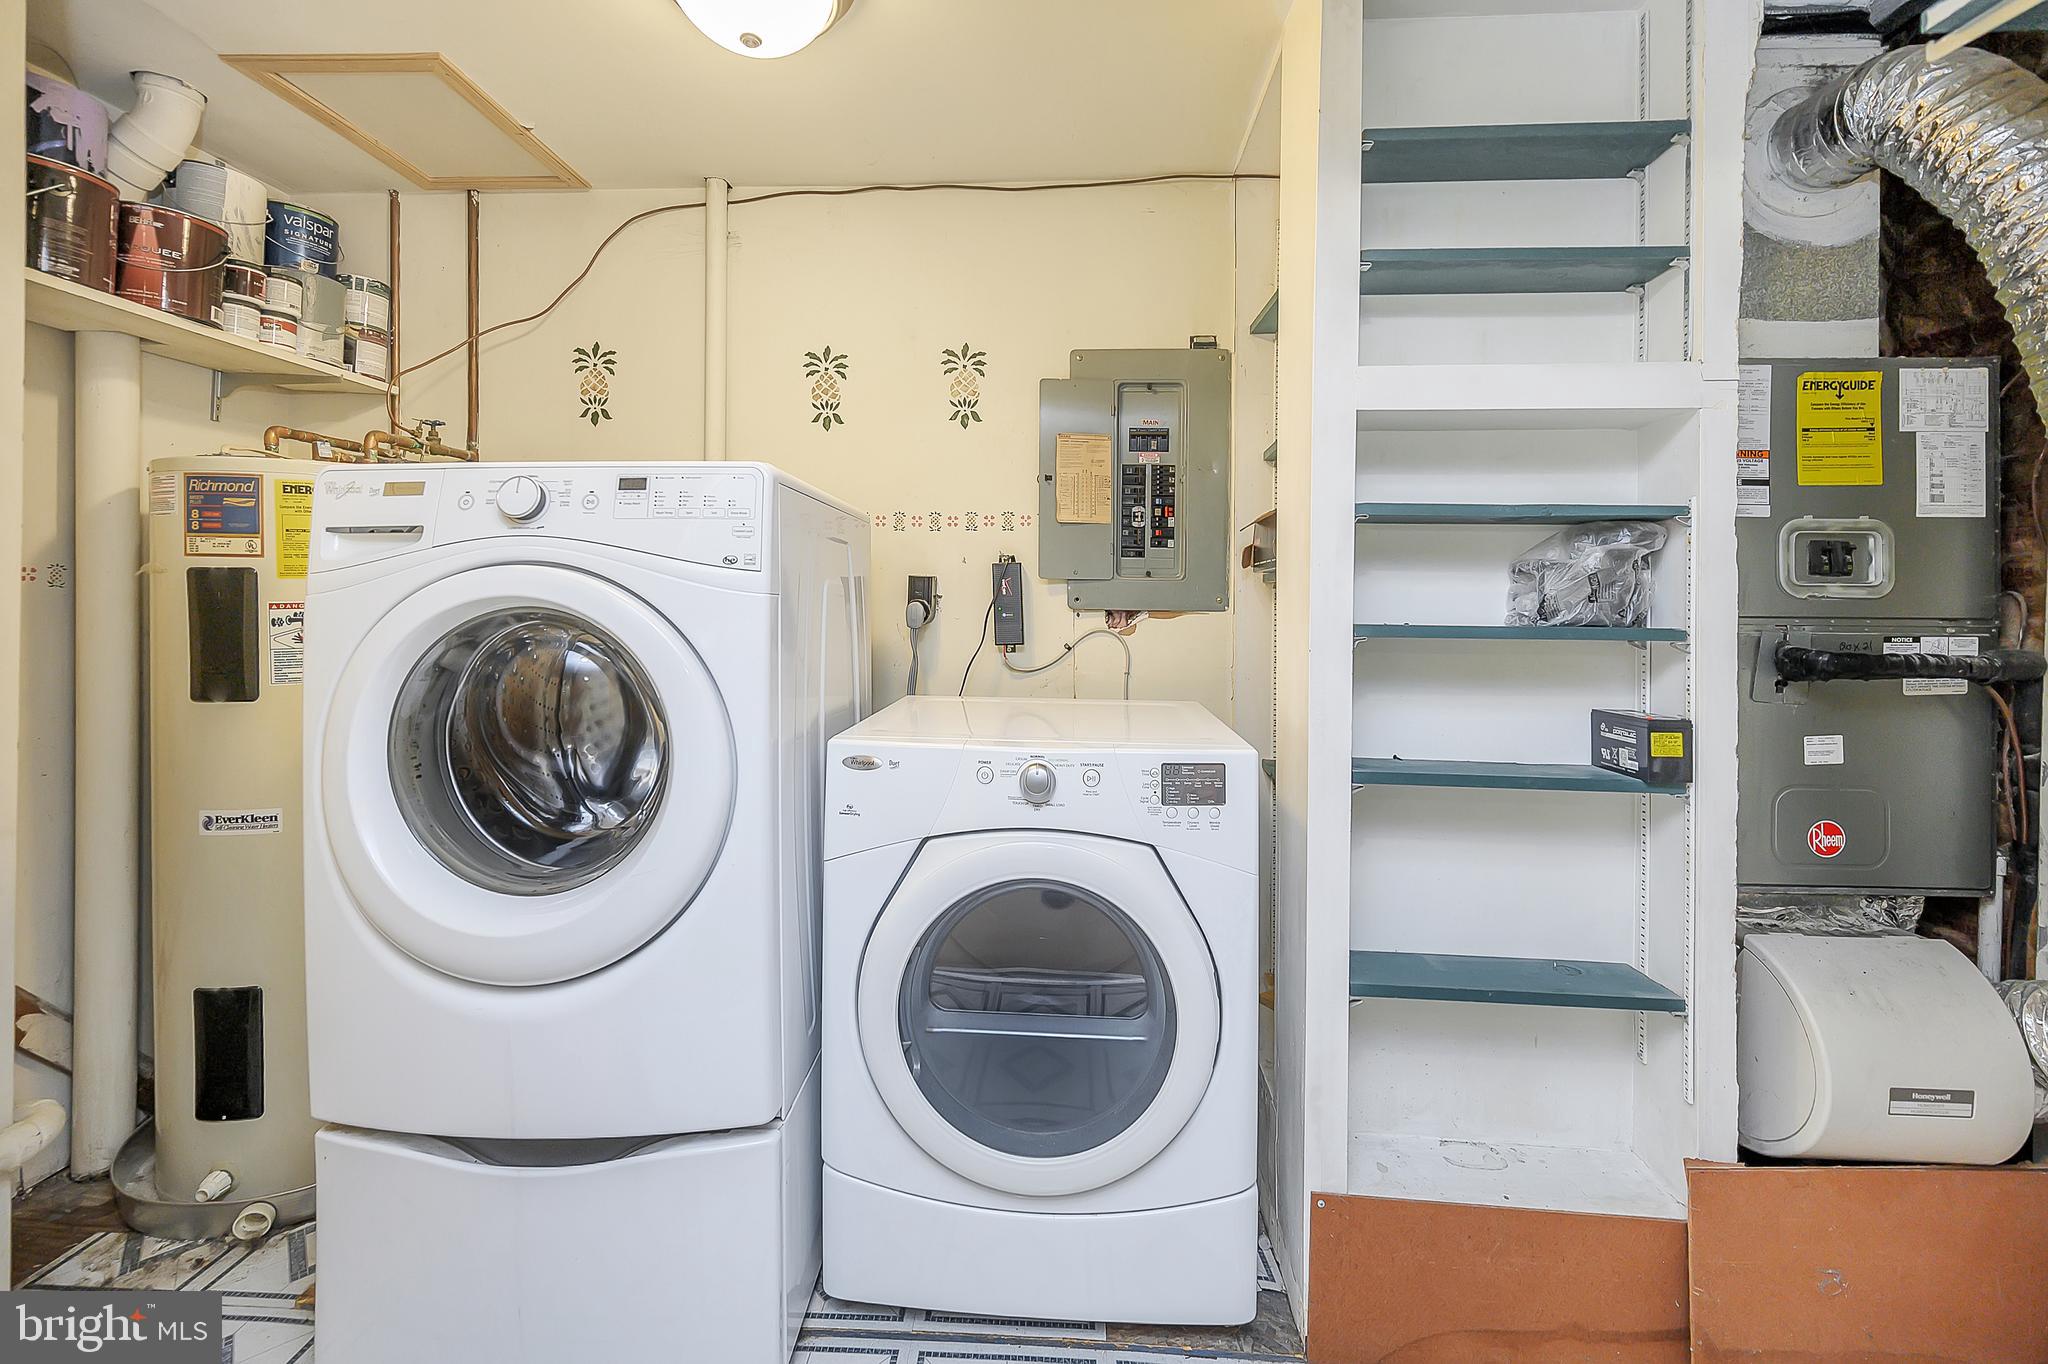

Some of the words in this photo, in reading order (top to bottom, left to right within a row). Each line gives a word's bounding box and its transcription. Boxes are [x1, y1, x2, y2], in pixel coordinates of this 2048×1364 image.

[283, 213, 335, 239] valspar
[283, 228, 333, 250] SIGNATURE
[1802, 380, 1876, 394] ENERGYGUIDE
[189, 479, 255, 493] Richmond
[191, 509, 200, 519] 8
[191, 520, 200, 531] 8
[850, 758, 875, 768] Whirlpool
[215, 814, 279, 824] EverKleen
[1812, 822, 1843, 852] Rheem
[1912, 1092, 1951, 1101] Honeywell
